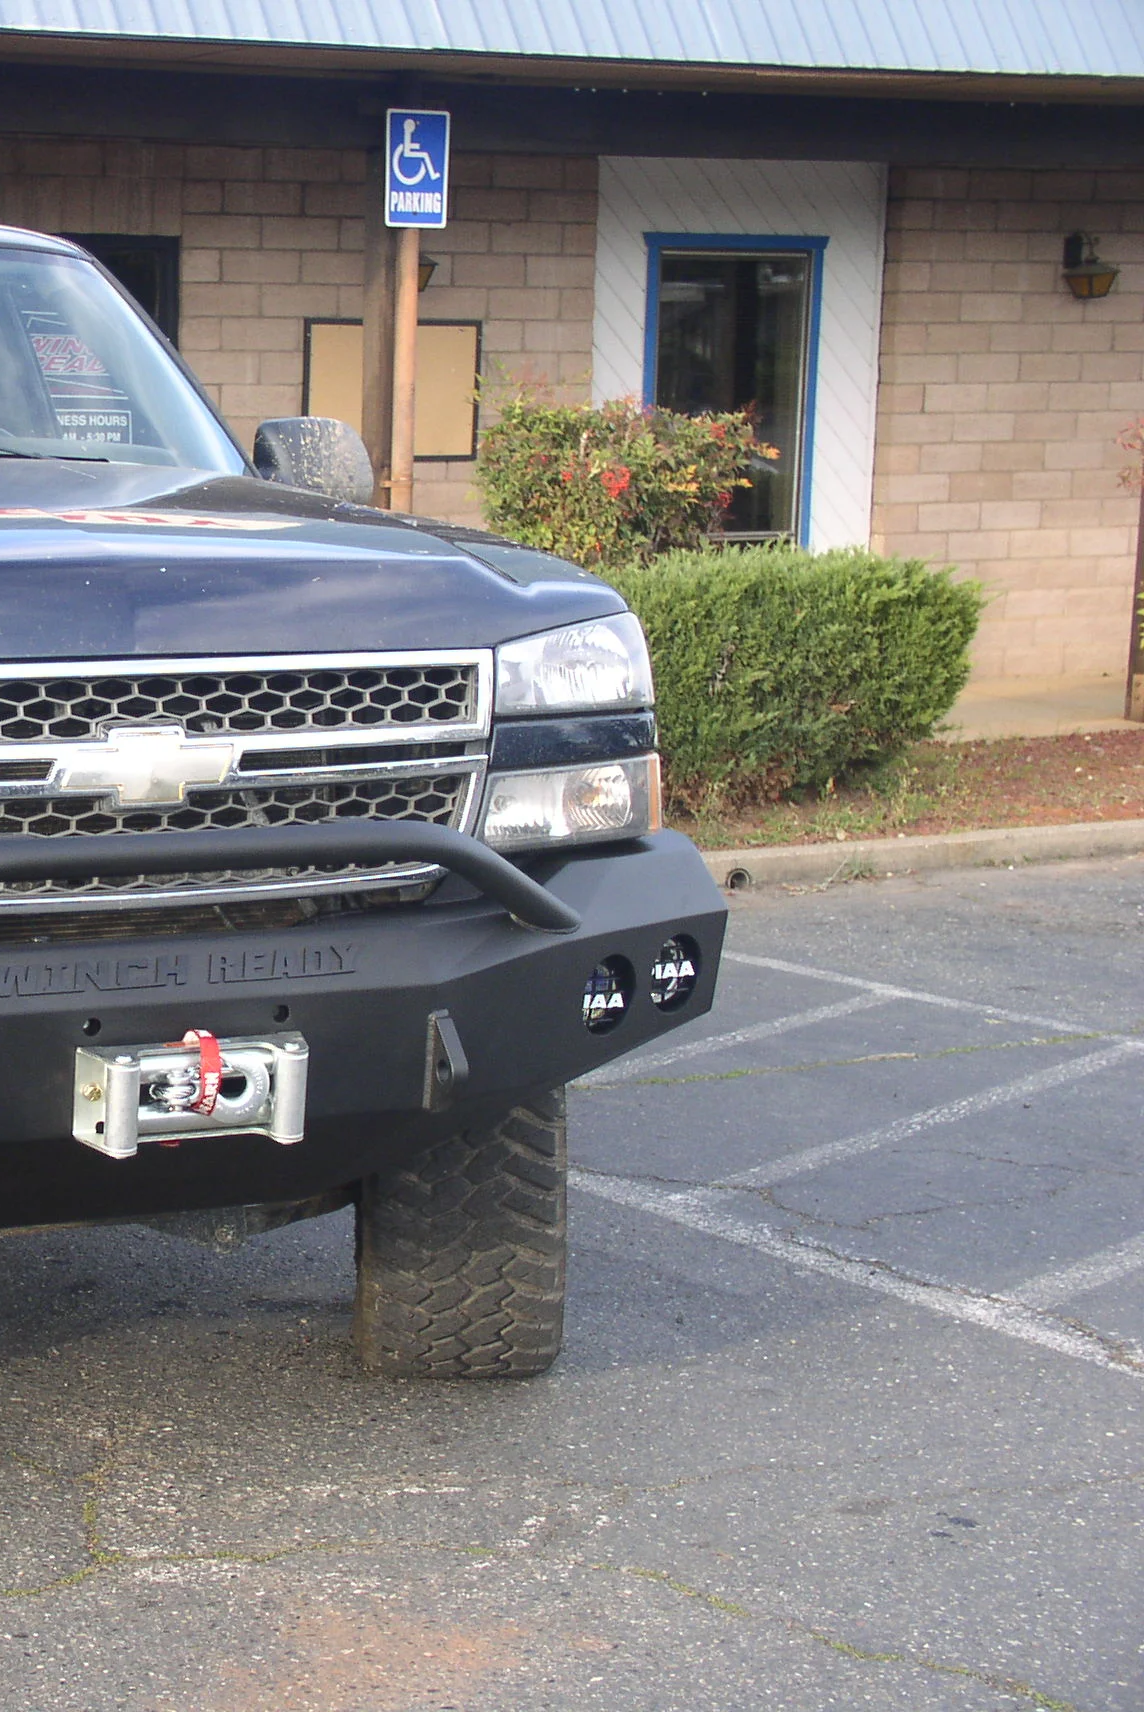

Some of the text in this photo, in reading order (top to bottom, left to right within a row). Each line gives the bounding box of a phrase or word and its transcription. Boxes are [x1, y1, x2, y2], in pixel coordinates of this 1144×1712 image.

[390, 190, 442, 213] PARKING
[88, 415, 128, 427] HOURS
[208, 942, 356, 984] READY
